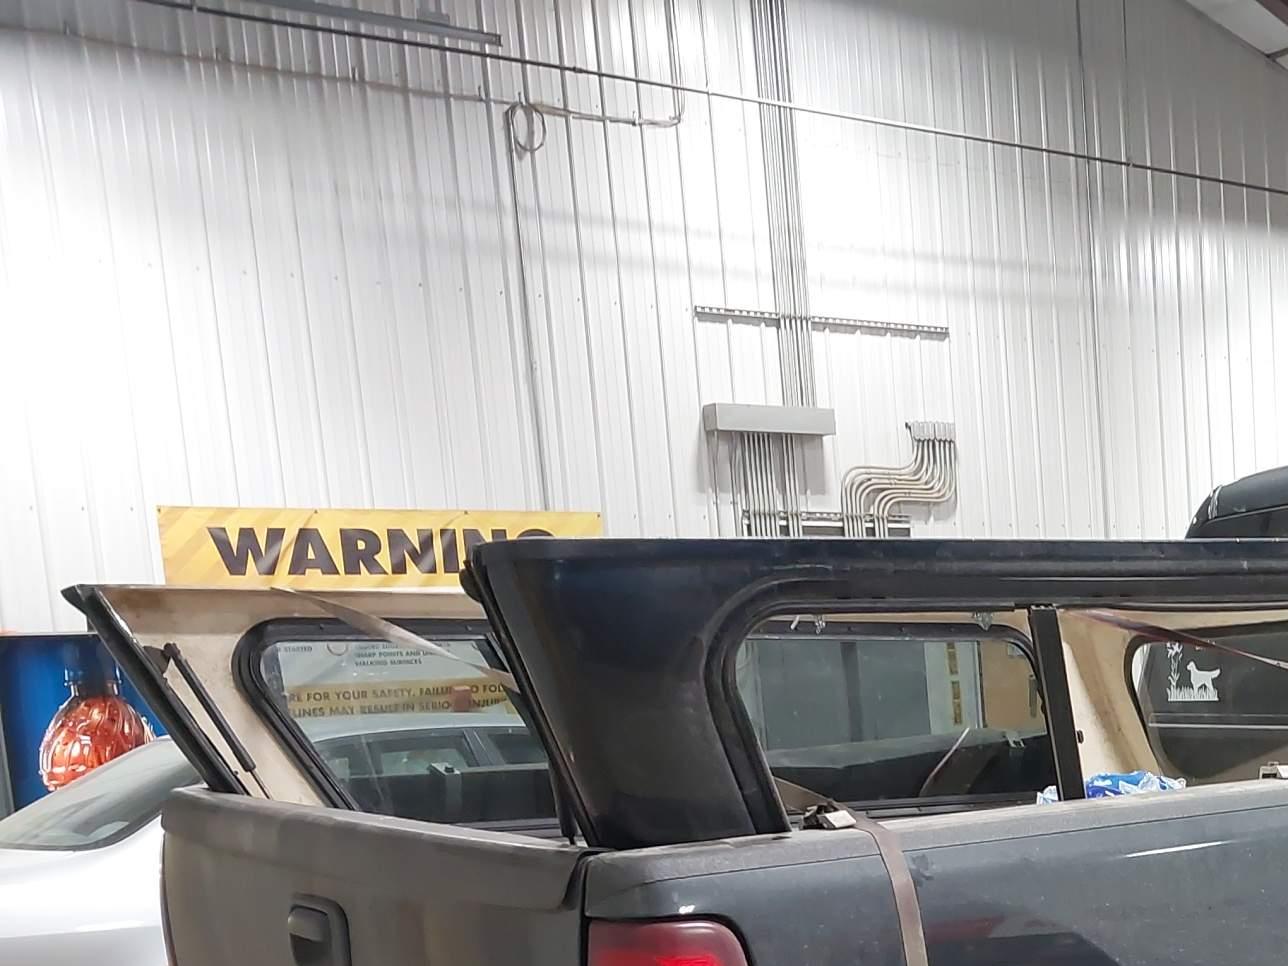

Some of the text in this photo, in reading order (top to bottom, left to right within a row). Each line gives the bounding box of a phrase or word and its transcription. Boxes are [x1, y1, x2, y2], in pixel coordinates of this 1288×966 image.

[207, 527, 555, 577] WARNI
[306, 691, 331, 702] FOR
[335, 689, 368, 701] YOUR
[419, 686, 452, 697] FAILU
[329, 704, 355, 716] MAY
[402, 703, 415, 712] IN
[420, 700, 451, 711] SERIO
